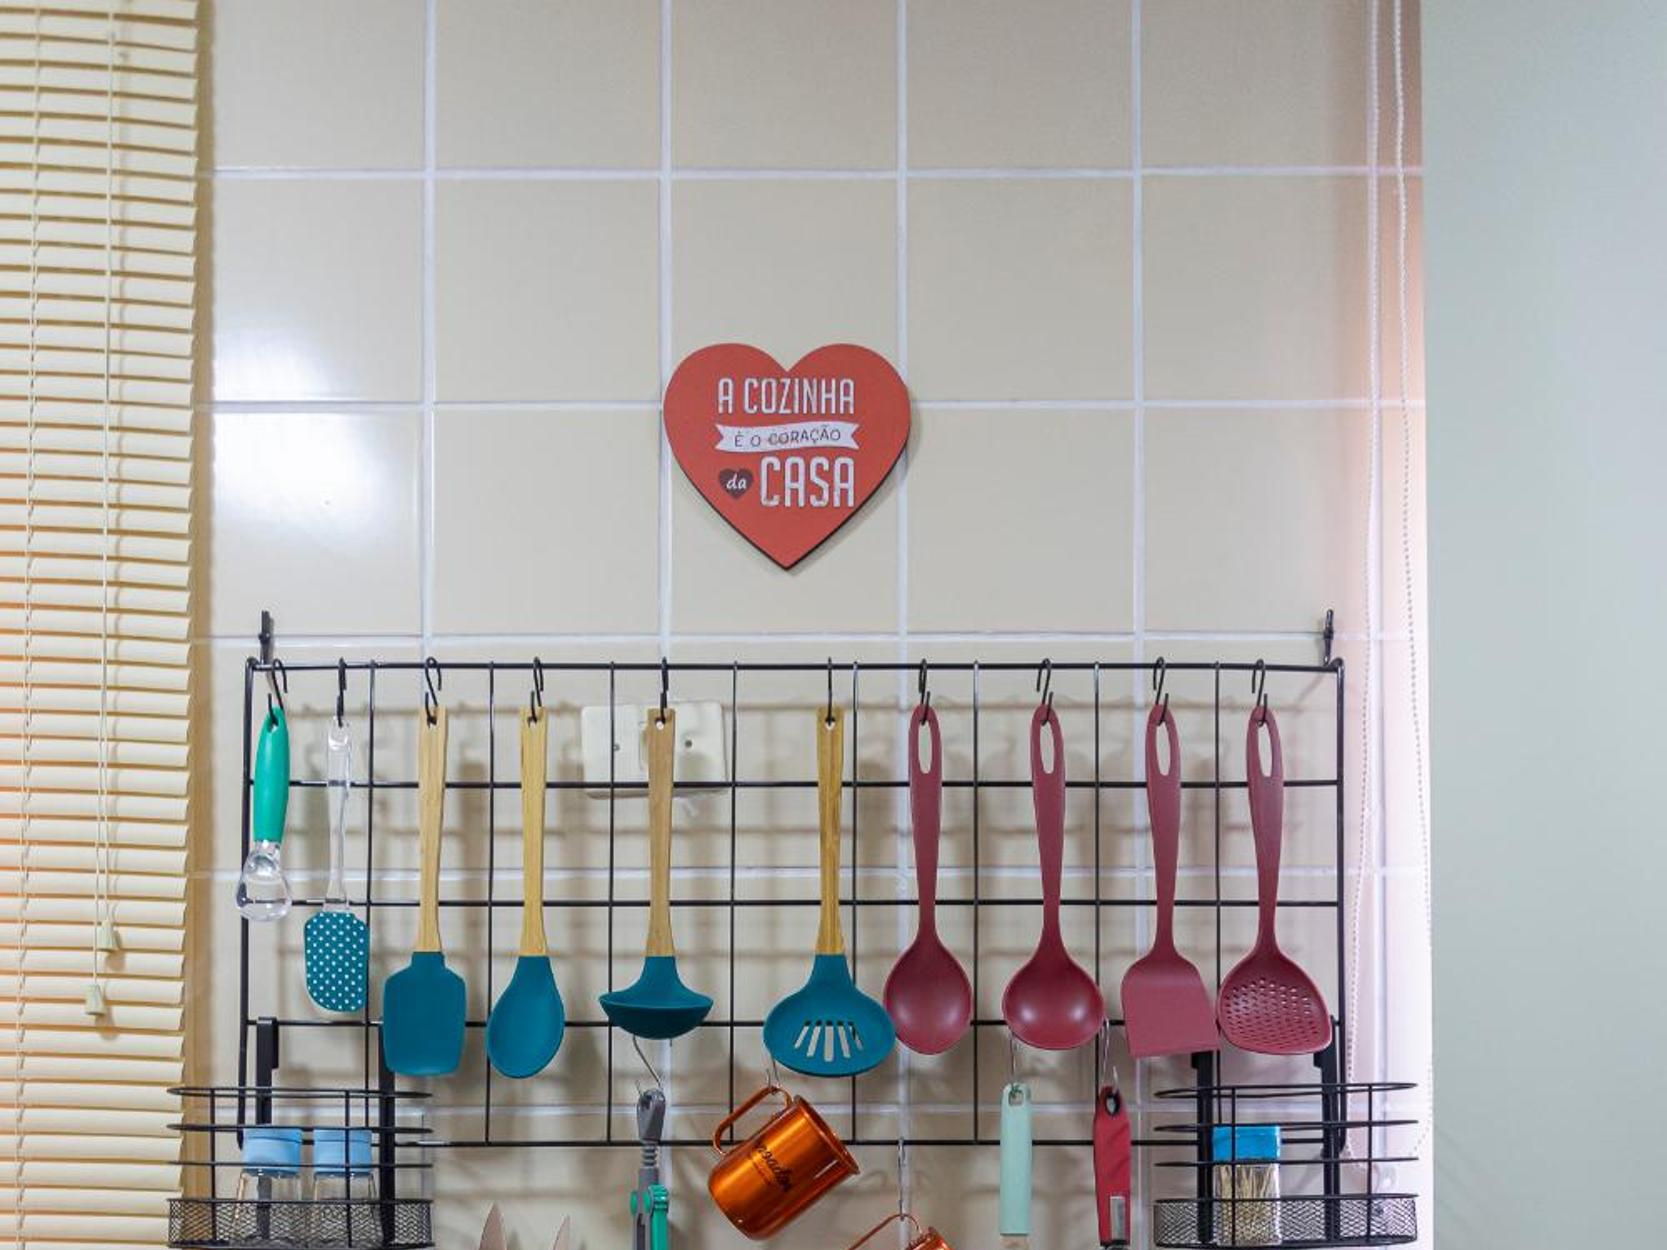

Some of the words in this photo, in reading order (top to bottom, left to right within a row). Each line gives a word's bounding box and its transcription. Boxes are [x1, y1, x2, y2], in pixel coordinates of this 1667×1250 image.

[717, 378, 734, 414] A
[743, 377, 855, 414] COZINHA
[734, 431, 744, 447] É
[750, 434, 761, 447] O
[768, 424, 842, 446] CORAÇÃO
[726, 472, 747, 490] da
[760, 456, 855, 507] CASA
